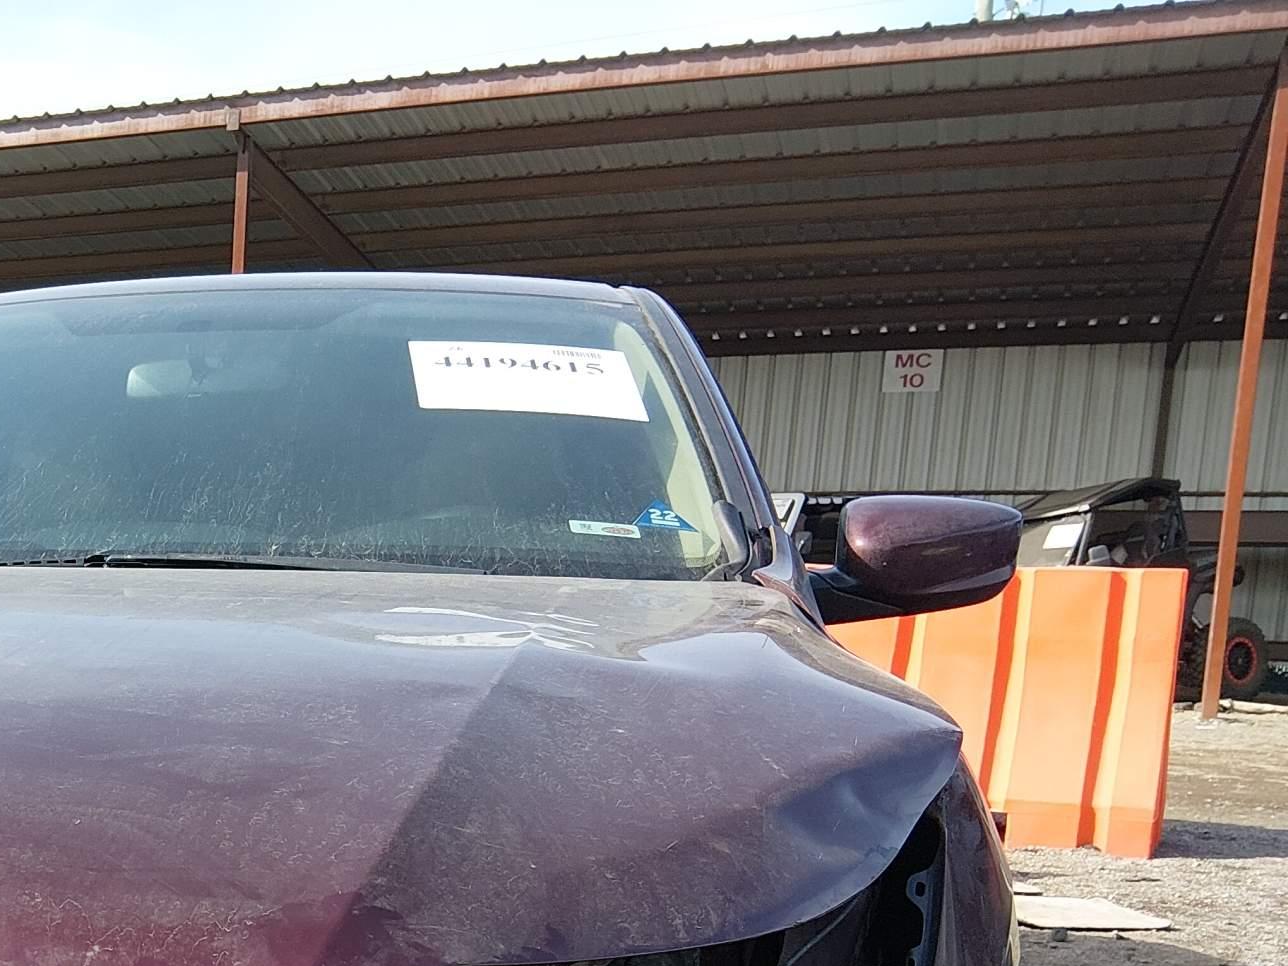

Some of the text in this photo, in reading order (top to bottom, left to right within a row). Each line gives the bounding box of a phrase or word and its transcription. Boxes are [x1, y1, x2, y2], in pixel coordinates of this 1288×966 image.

[895, 353, 932, 368] MC
[899, 373, 924, 388] 10
[648, 508, 678, 521] 22
